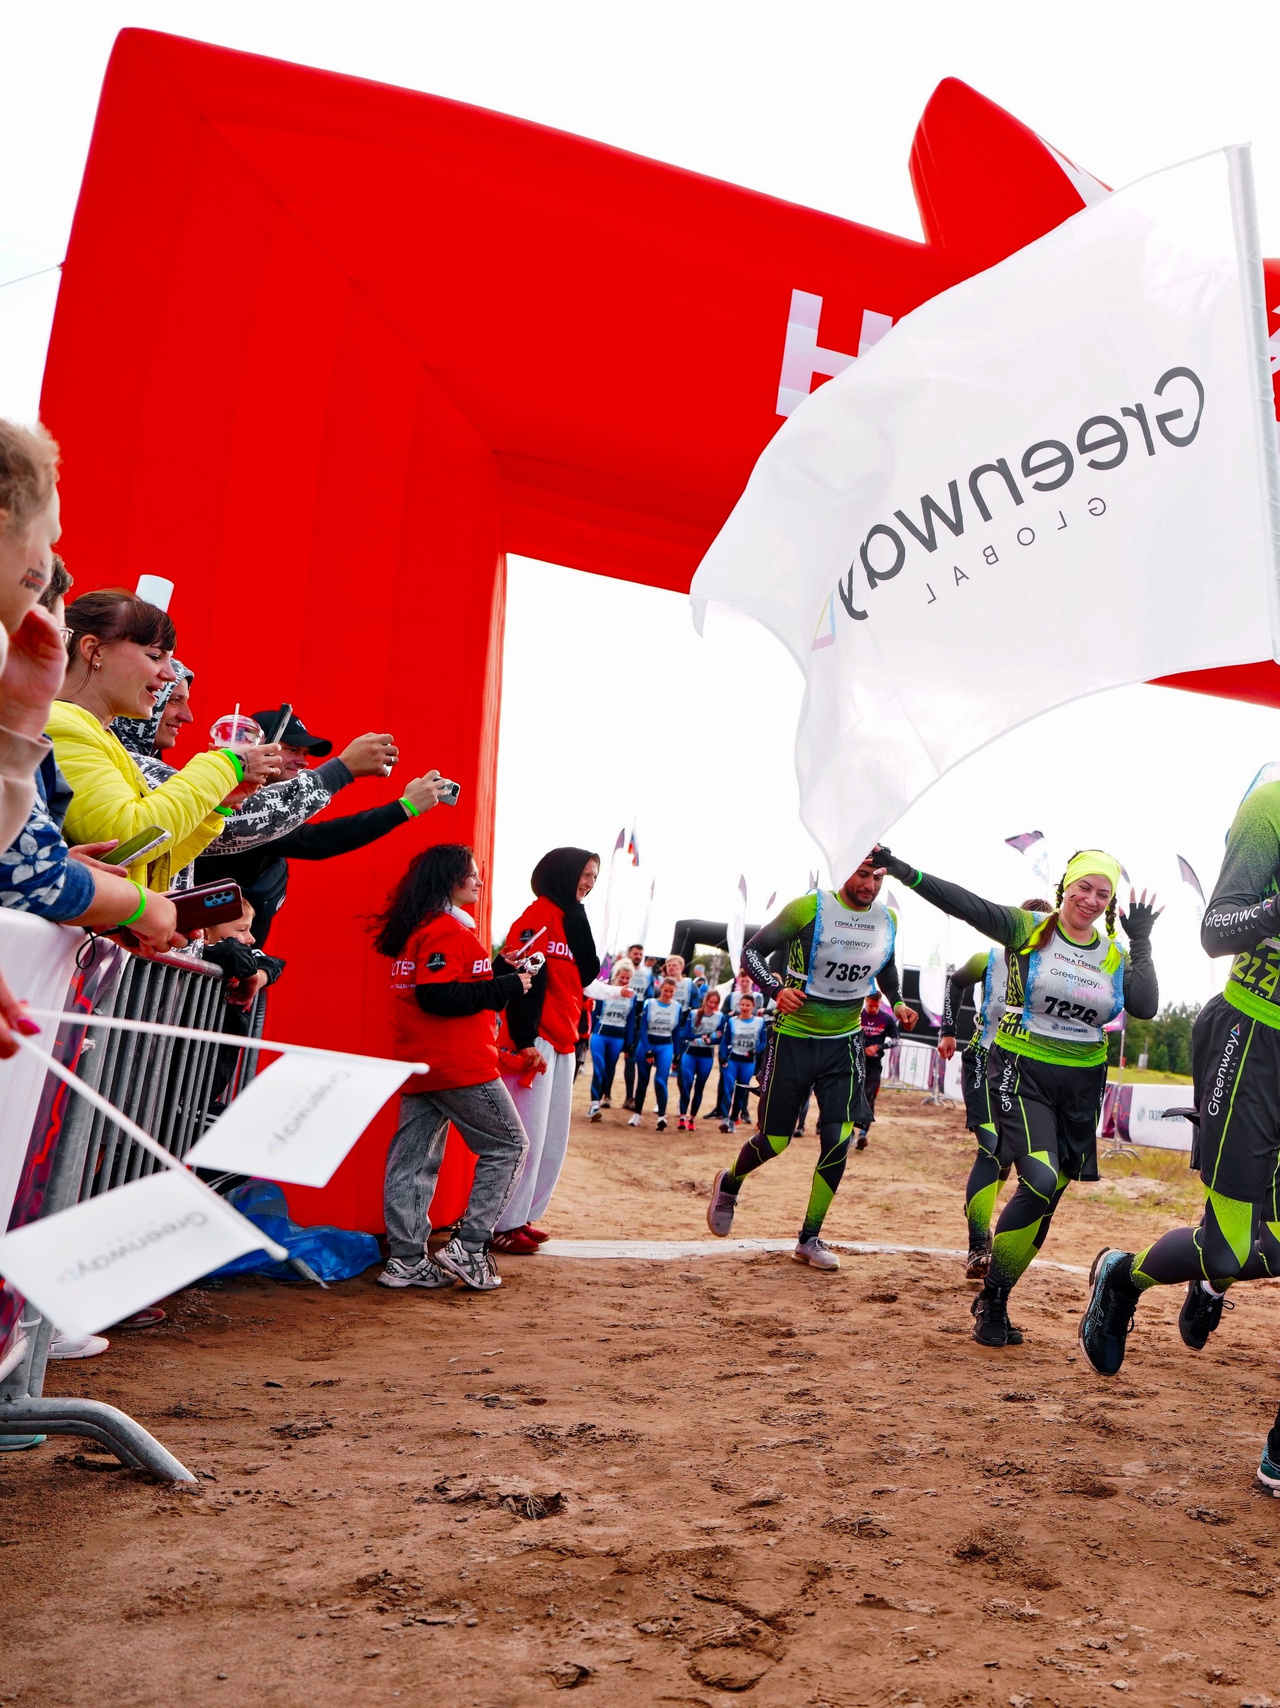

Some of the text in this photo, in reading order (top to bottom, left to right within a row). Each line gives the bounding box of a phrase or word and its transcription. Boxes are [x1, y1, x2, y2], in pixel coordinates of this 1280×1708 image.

[1219, 923, 1255, 938] GLOBAL
[830, 936, 871, 950] Greenway
[1054, 952, 1076, 964] ГОНКА
[825, 960, 871, 982] 7363
[1049, 967, 1099, 990] Greenway
[1044, 995, 1098, 1026] 7276
[1207, 1032, 1240, 1116] Greenway
